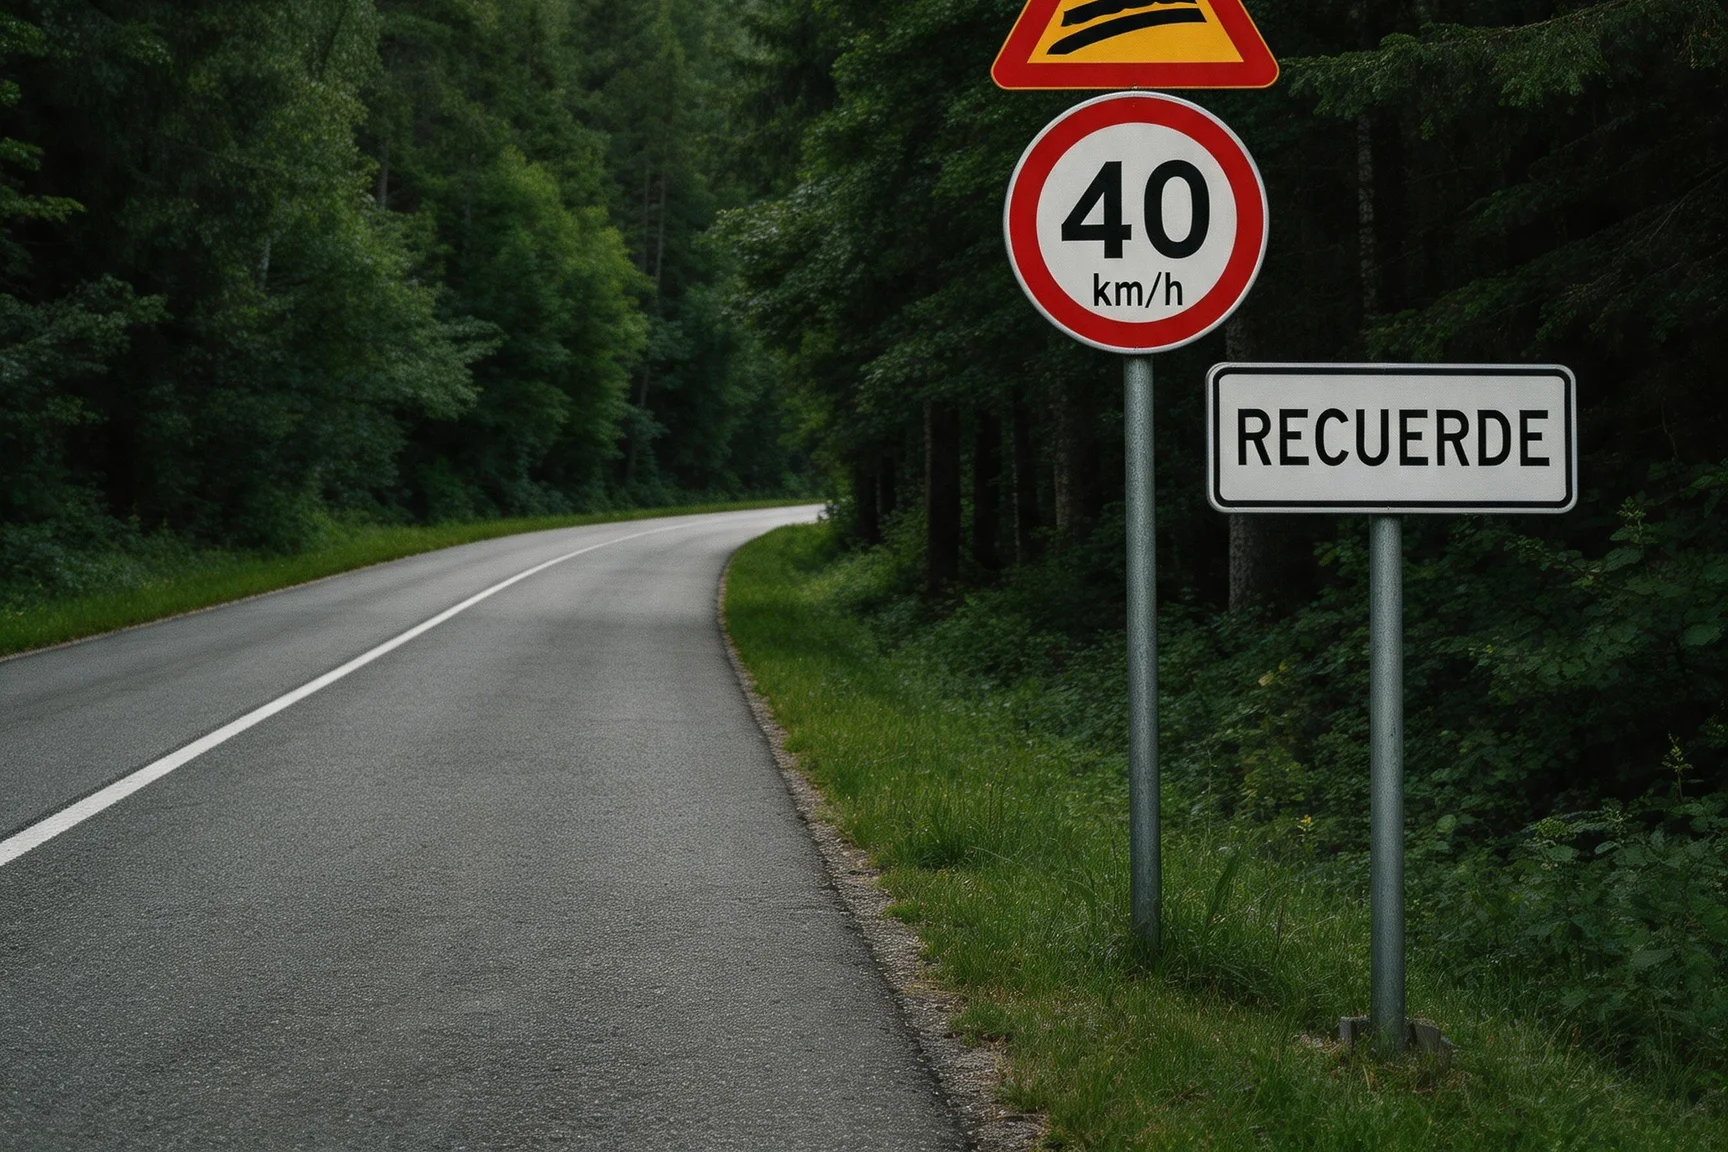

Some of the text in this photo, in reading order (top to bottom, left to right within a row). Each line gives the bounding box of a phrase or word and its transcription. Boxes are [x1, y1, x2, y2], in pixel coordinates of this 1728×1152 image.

[1060, 159, 1211, 260] 40
[1093, 271, 1183, 309] km/h
[1237, 407, 1551, 467] RECUERDE
